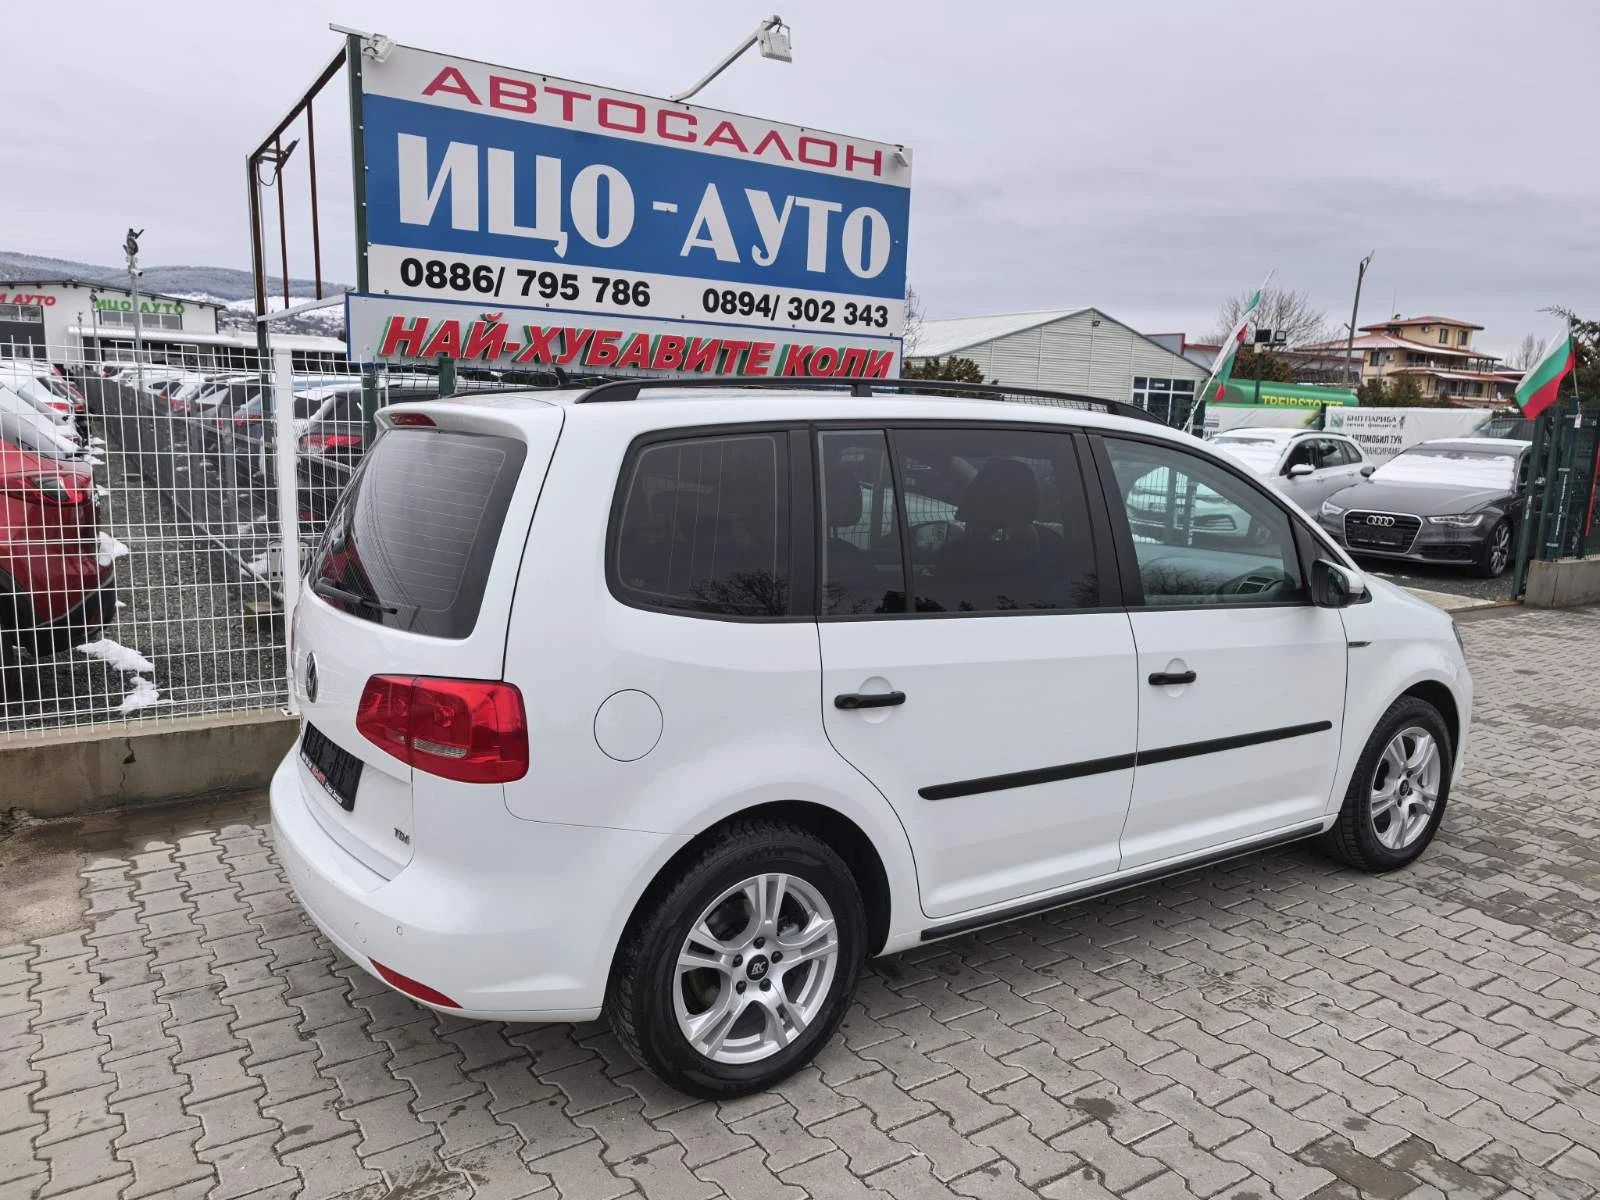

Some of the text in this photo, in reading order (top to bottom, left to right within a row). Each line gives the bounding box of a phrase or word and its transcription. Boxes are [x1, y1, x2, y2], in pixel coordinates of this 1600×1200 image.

[421, 66, 883, 176] АВТОСАЛОН
[397, 132, 635, 258] ИЦО
[12, 293, 57, 306] АУТО
[516, 268, 580, 301] 795
[592, 276, 651, 307] 786
[140, 302, 184, 315] АУТО
[787, 297, 836, 324] 302
[843, 302, 889, 328] 343
[378, 312, 895, 379] НАЙ-ХУБАВИТЕ КОЛИ
